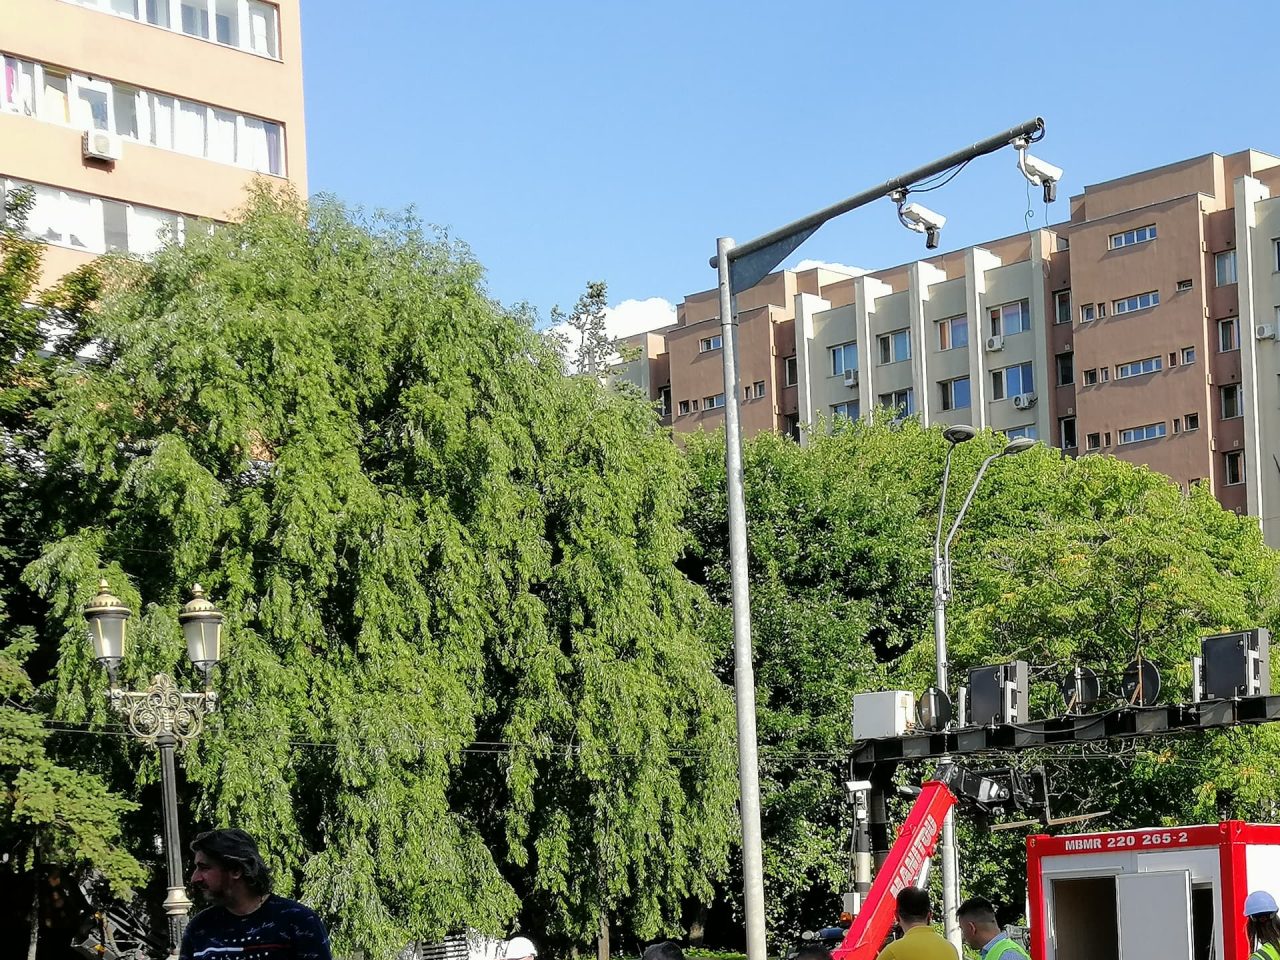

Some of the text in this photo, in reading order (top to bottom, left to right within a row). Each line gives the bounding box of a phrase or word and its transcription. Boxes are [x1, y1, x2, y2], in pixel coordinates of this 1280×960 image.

[1065, 832, 1188, 851] MBMR 220 265-2
